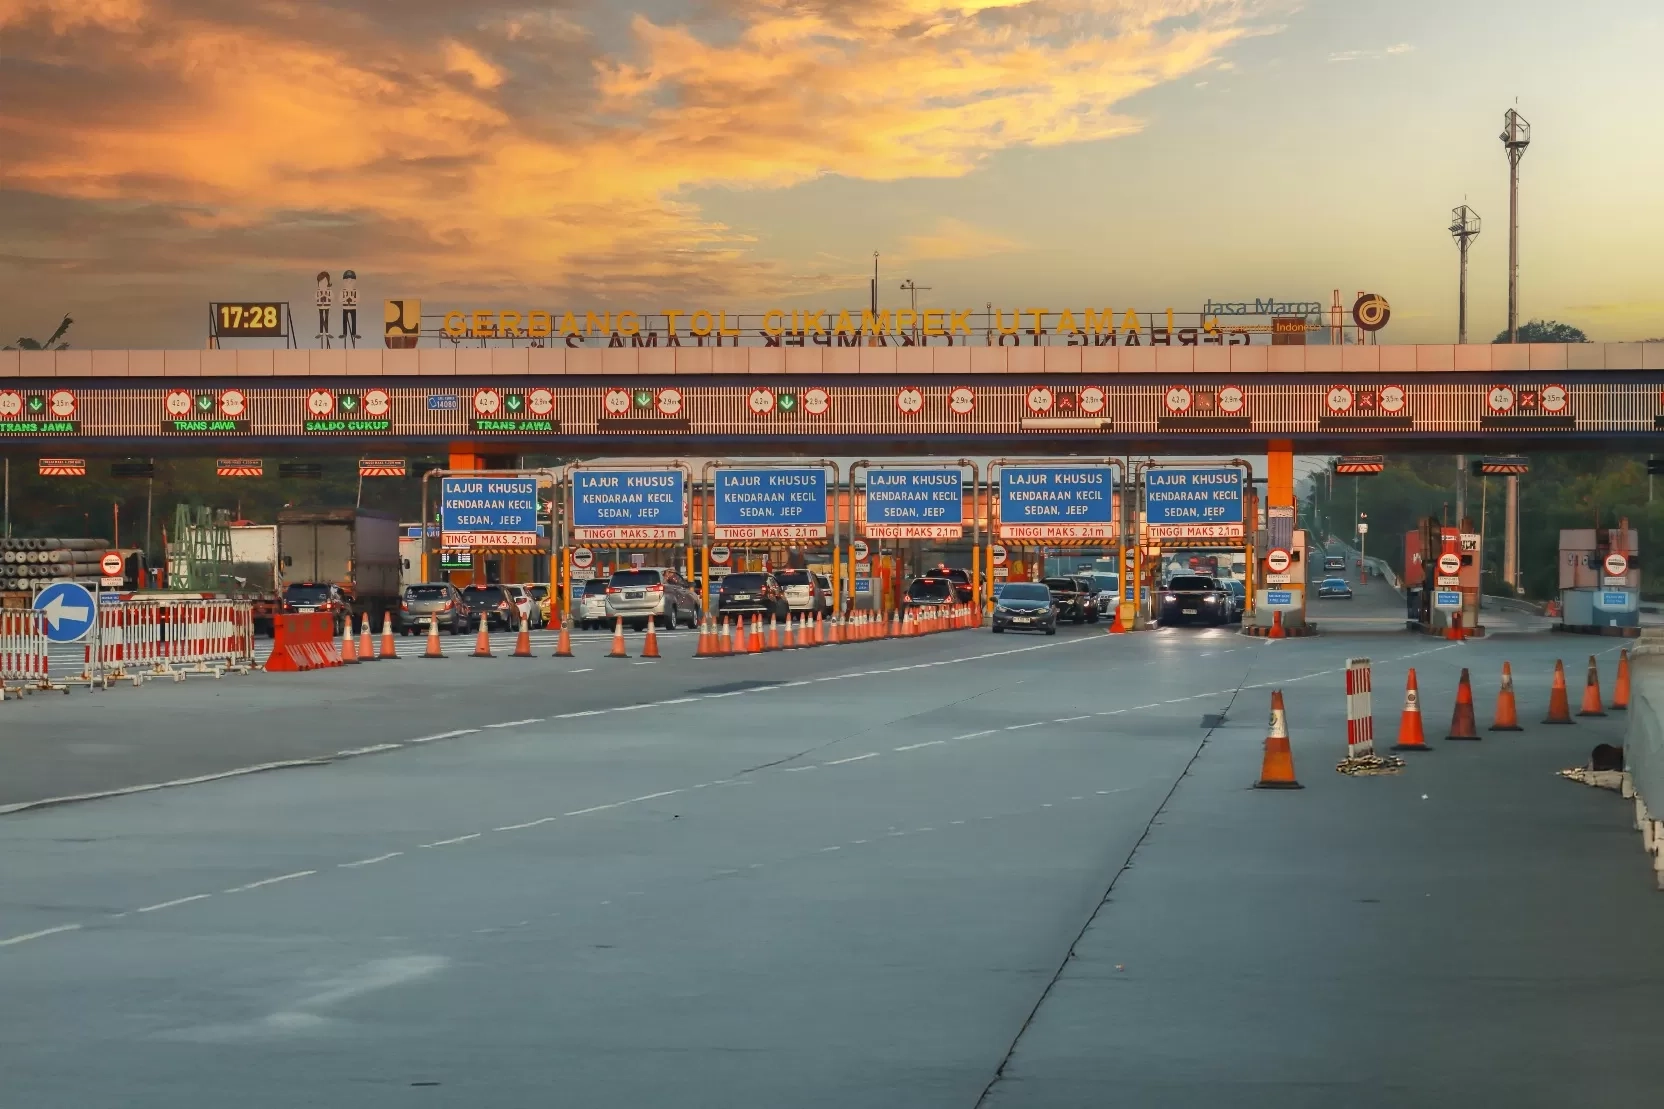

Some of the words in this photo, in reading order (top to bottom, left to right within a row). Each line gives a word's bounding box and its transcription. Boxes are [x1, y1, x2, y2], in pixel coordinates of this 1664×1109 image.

[1204, 298, 1247, 315] Jasa
[1255, 297, 1321, 318] Marga
[221, 306, 278, 329] 17:28
[443, 309, 640, 336] GERBANG
[661, 309, 741, 336] TOL
[762, 308, 973, 336] CIKAMPEK
[996, 308, 1142, 335] UTAMA
[0, 422, 37, 432] TRANS
[40, 422, 73, 432] JAWA
[174, 421, 208, 431] TRANS
[209, 421, 236, 431] JAWA
[306, 421, 345, 431] SALDO
[349, 421, 389, 430] CUKUP
[476, 420, 516, 430] TRANS
[518, 421, 552, 431] JAWA
[582, 477, 619, 488] LAJUR
[627, 476, 674, 487] KHUSUS
[724, 476, 761, 487] LAJUR
[769, 475, 817, 485] KHUSUS
[870, 475, 907, 485] LAJUR
[912, 475, 958, 485] KHUSUS
[1009, 474, 1048, 485] LAJUR
[1055, 474, 1103, 484] KHUSUS
[1149, 475, 1187, 485] LAJUR
[1192, 474, 1238, 485] KHUSUS
[446, 483, 483, 493] LAJUR
[488, 483, 533, 494] KHUSUS
[583, 494, 643, 503] KENDARAAN
[648, 493, 674, 503] KECIL
[724, 493, 785, 503] KENDARAAN
[790, 492, 817, 502] KECIL
[869, 491, 928, 501] KENDARAAN
[932, 491, 959, 501] KECIL
[1009, 491, 1071, 501] KENDARAAN
[1076, 490, 1103, 500] KECIL
[1149, 491, 1208, 502] KENDARAAN
[1213, 490, 1239, 500] KECIL
[446, 499, 505, 509] KENDARAAN
[508, 499, 533, 509] KECIL
[597, 508, 632, 519] SEDAN,
[637, 508, 660, 518] JEEP
[739, 507, 775, 517] SEDAN,
[779, 507, 803, 516] JEEP
[884, 507, 919, 518] SEDAN,
[922, 507, 945, 517] JEEP
[1024, 505, 1061, 516] SEDAN,
[1065, 505, 1089, 515] JEEP
[1164, 507, 1200, 518] SEDAN,
[1202, 507, 1225, 516] JEEP
[457, 515, 494, 526] SEDAN,
[499, 515, 522, 525] JEEP
[583, 529, 616, 538] TINGGI
[620, 529, 651, 538] MAKS.
[723, 529, 756, 538] TINGGI
[761, 528, 792, 537] MAKS.
[870, 527, 902, 537] TINGGI
[1009, 527, 1042, 537] TINGGI
[1047, 527, 1078, 537] MAKS.
[1150, 527, 1183, 537] TINGGI
[445, 535, 477, 544] TINGGI
[481, 535, 510, 544] MAKS.
